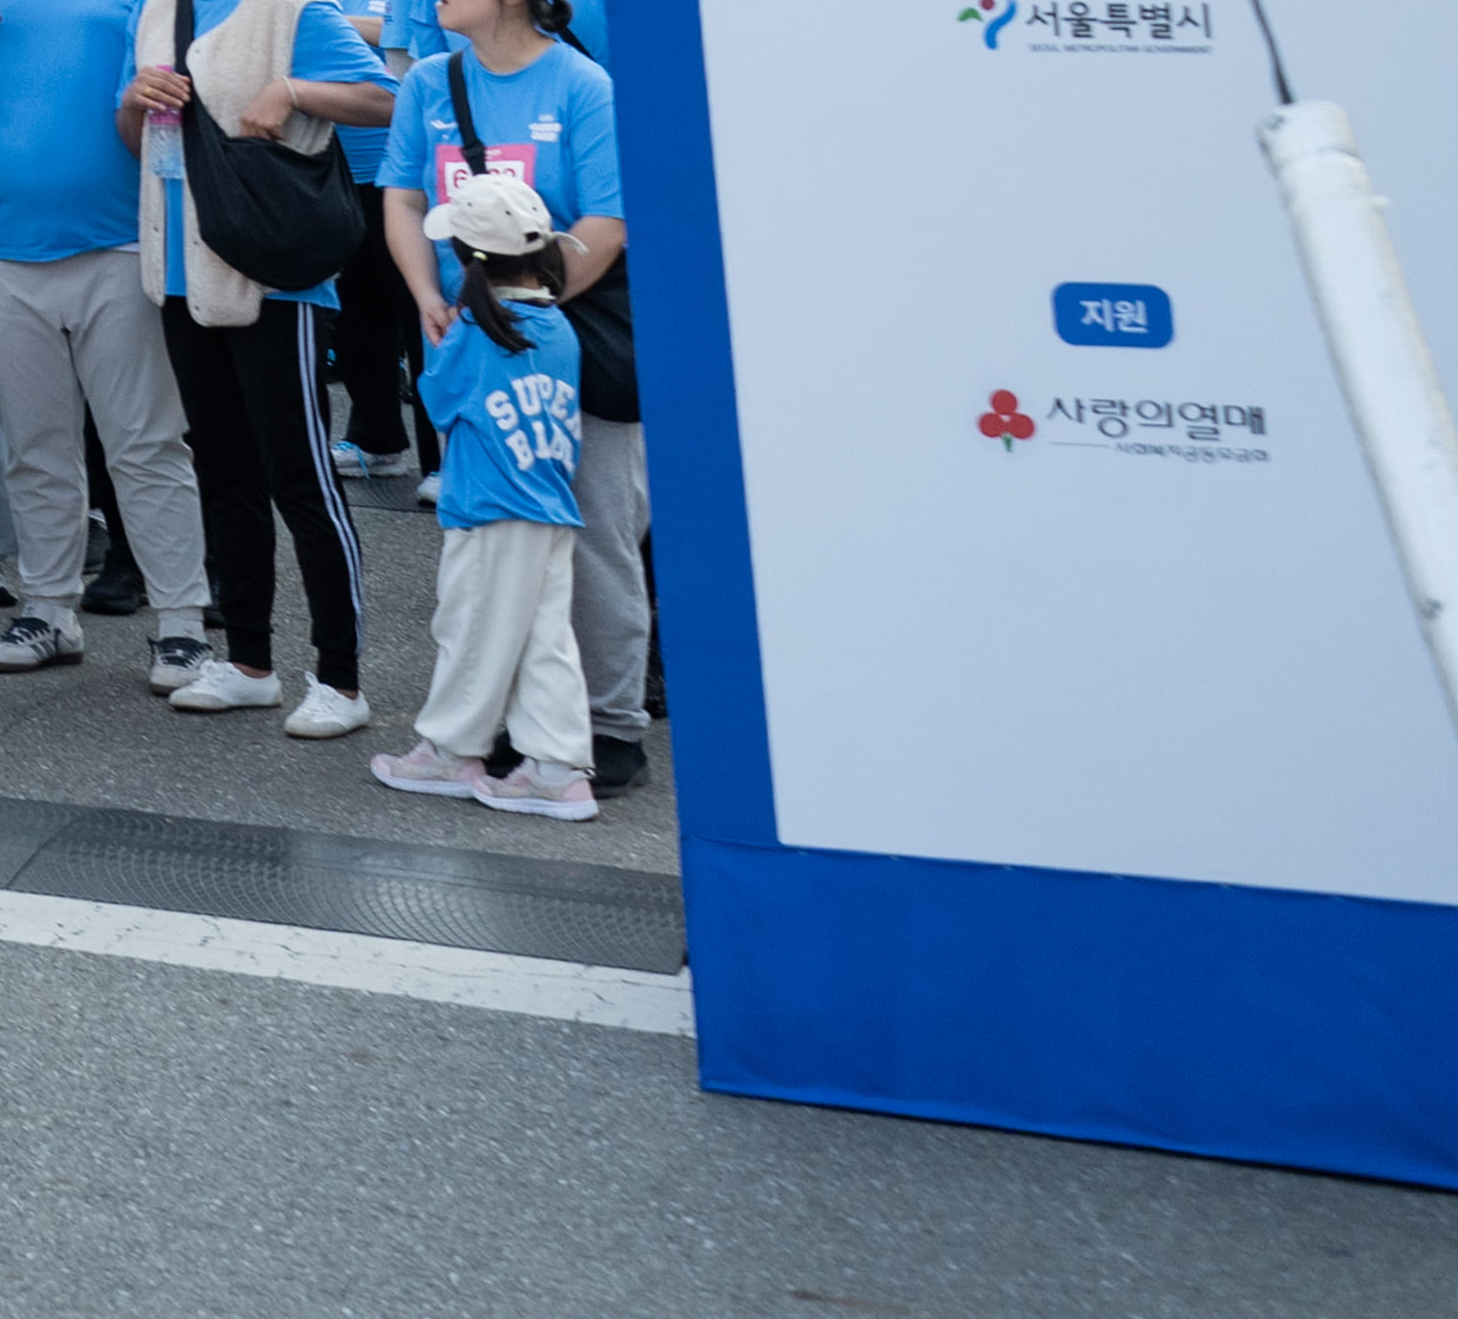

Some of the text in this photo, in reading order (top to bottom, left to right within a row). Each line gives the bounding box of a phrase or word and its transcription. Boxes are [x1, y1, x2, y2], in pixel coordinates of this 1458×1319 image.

[1026, 1, 1212, 39] 서울특별시
[1080, 300, 1149, 332] 지원
[1046, 397, 1266, 441] 사랑의열매
